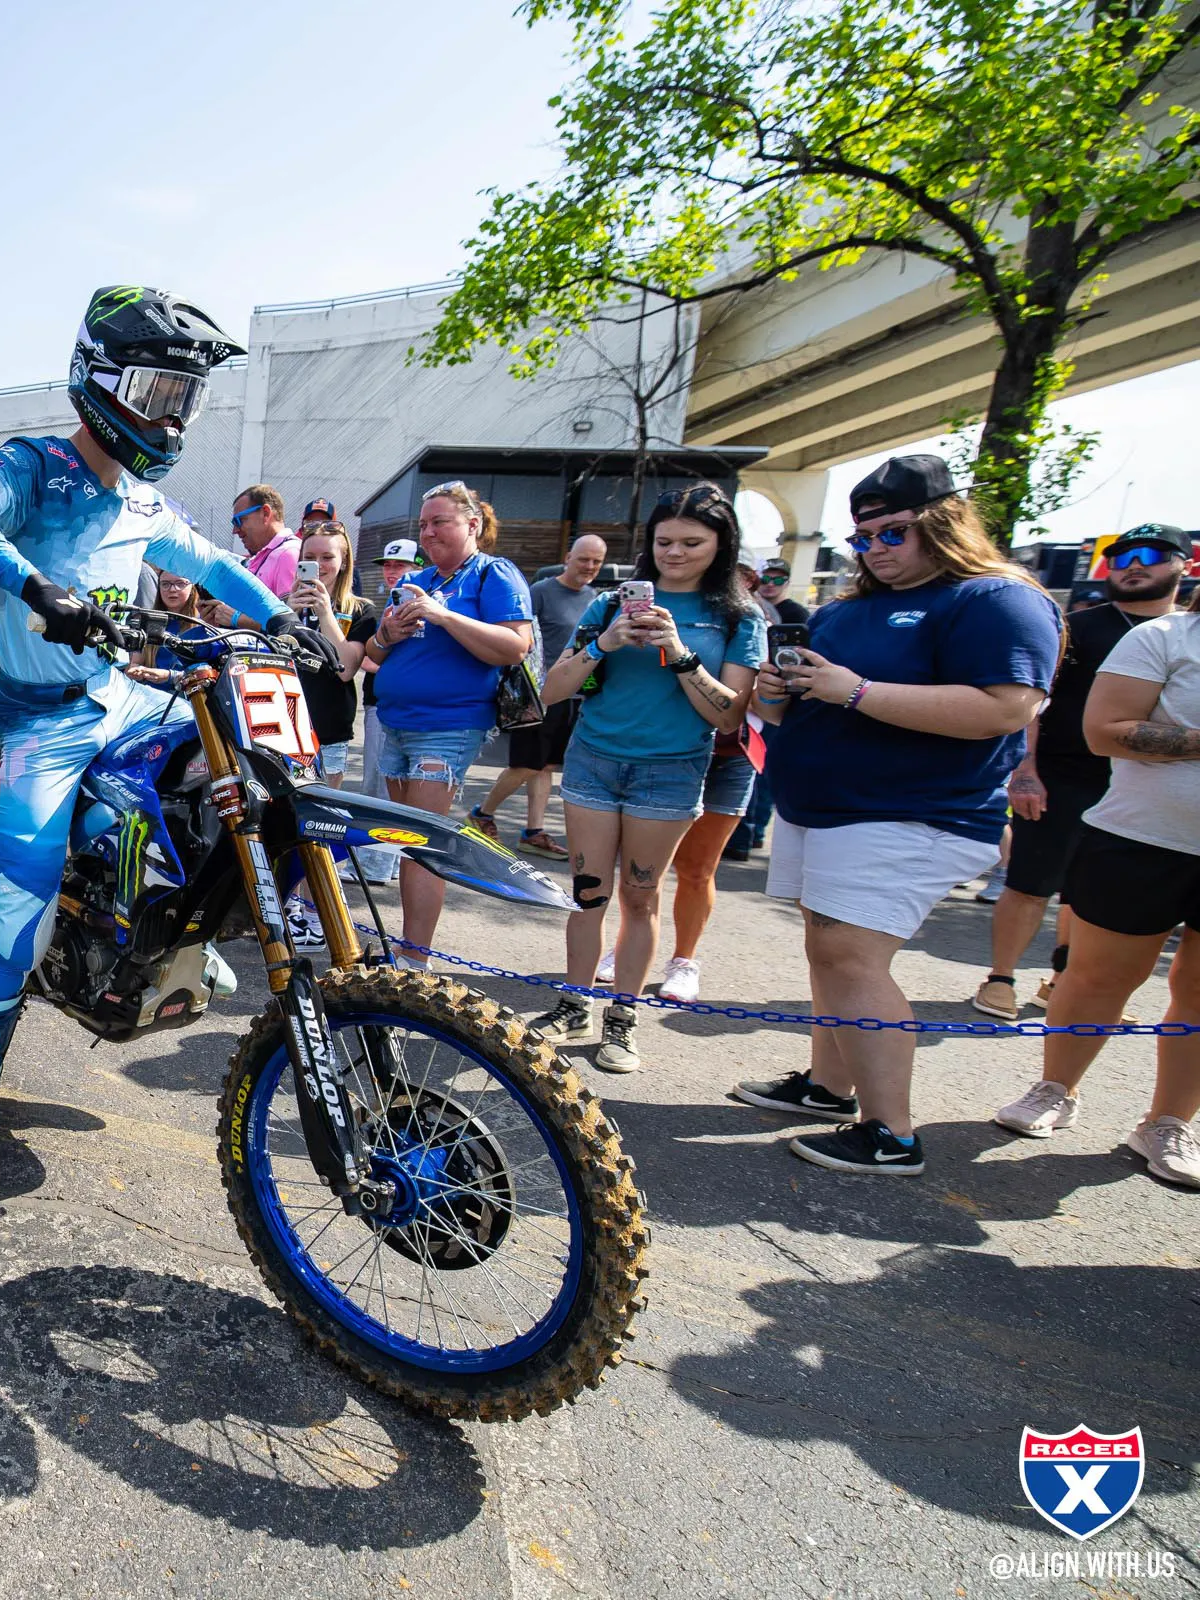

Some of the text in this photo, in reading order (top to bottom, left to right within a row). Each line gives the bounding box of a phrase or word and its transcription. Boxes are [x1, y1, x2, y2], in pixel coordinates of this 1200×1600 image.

[80, 395, 119, 443] MONSTER
[387, 545, 402, 555] 3
[314, 822, 347, 834] YAMAHA
[255, 884, 269, 924] RACING
[289, 1014, 311, 1068] BRAKING
[297, 995, 346, 1128] DUNLOP
[231, 1074, 252, 1164] DUNLOP
